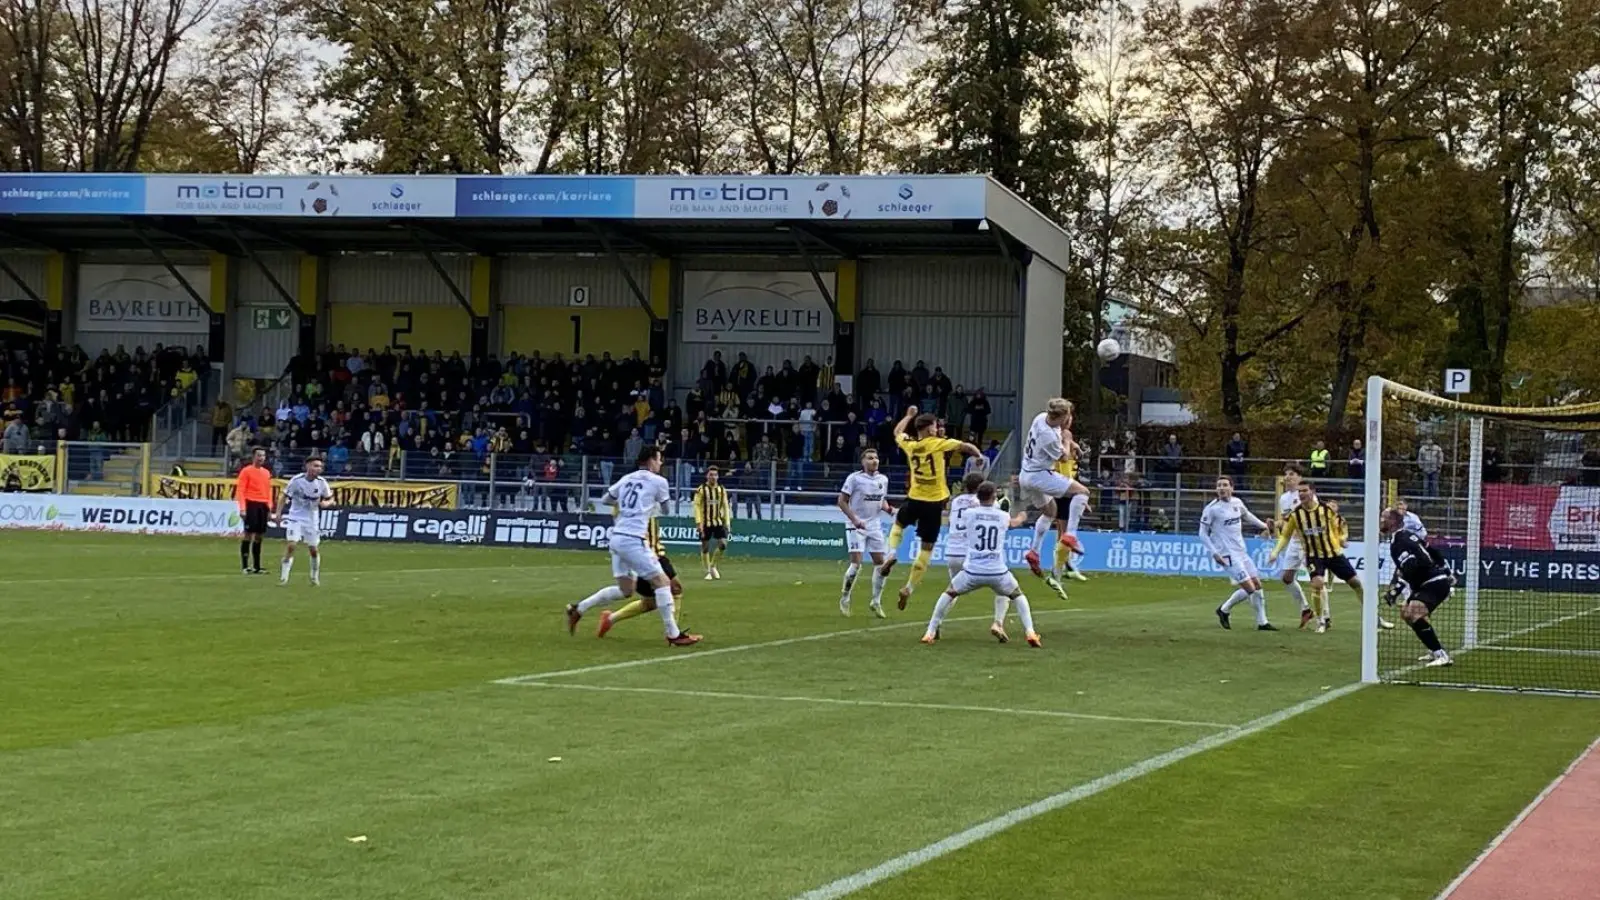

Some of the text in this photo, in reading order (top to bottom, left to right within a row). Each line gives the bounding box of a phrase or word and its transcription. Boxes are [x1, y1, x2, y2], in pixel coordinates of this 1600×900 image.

[2, 187, 130, 200] schlaeger.com/karriere
[177, 181, 284, 198] motion
[472, 190, 612, 203] schlaeger.com/karriere
[670, 183, 788, 201] motion
[371, 202, 421, 212] schlaeger
[878, 203, 933, 214] schlaeger
[573, 287, 585, 304] 0
[89, 299, 201, 320] BAYREUTH
[696, 308, 821, 332] BAYREUTH
[392, 311, 412, 350] 2
[570, 315, 581, 354] 1
[1452, 371, 1465, 389] P
[911, 453, 936, 477] 21
[621, 481, 643, 509] 26
[413, 515, 487, 540] capelli
[658, 526, 700, 541] KURIE
[445, 535, 484, 543] SPORT
[728, 533, 844, 548] Deine Zeitung mit Heimvorteil
[974, 525, 999, 551] 30
[1130, 555, 1224, 572] BRAUHAU
[1500, 560, 1540, 579] THE
